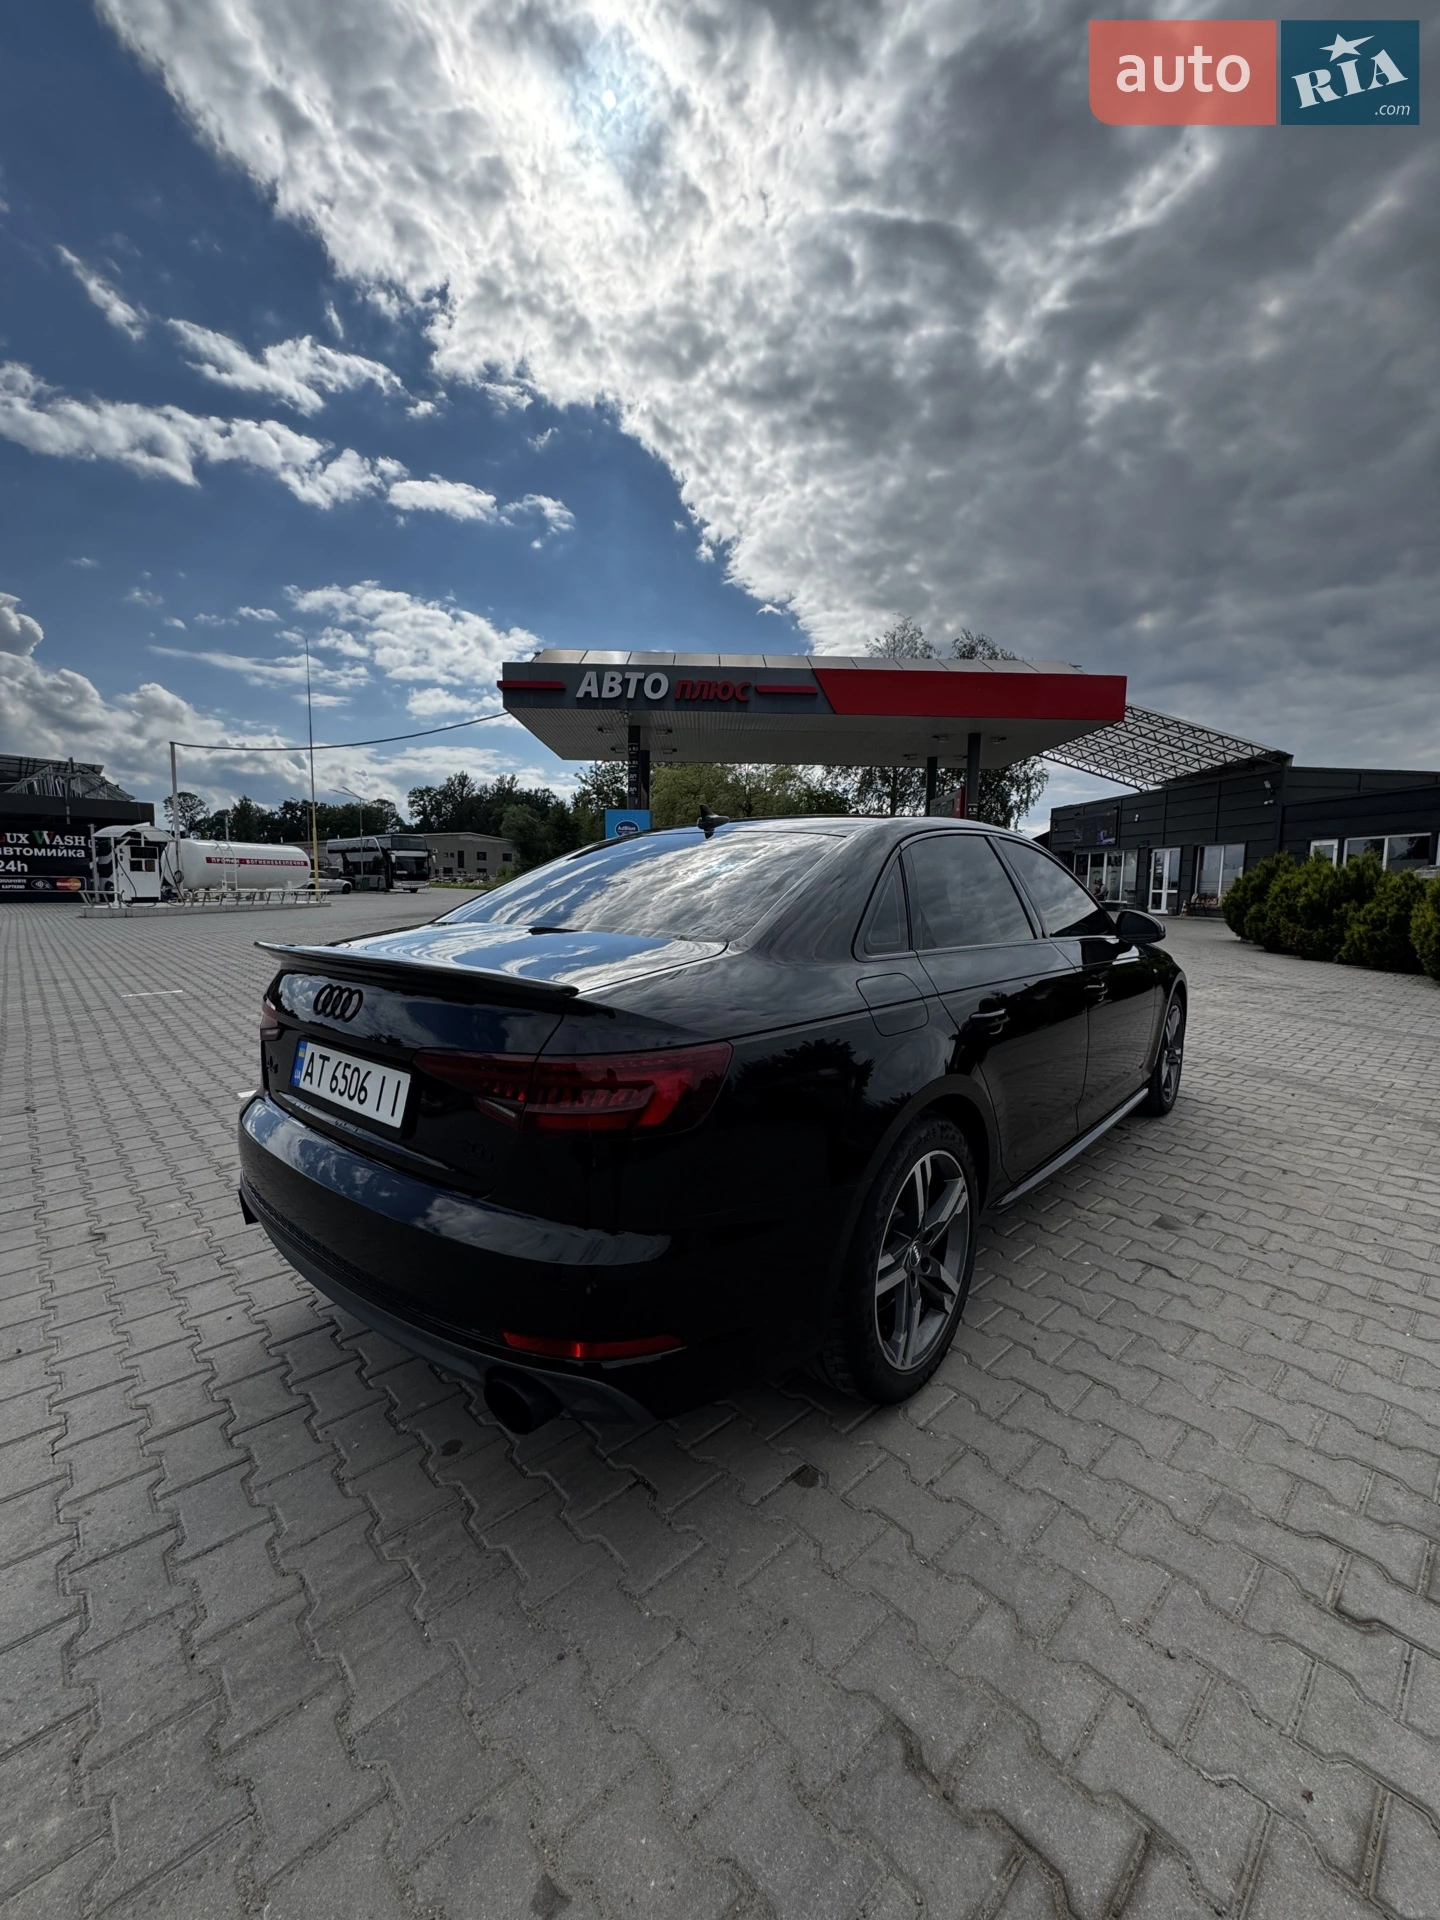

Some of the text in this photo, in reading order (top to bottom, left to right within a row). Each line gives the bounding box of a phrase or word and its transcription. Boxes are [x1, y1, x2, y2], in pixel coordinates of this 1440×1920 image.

[575, 671, 752, 701] АВТО ПЛЮС
[33, 830, 86, 846] WASH
[0, 846, 85, 858] втомийка
[303, 1051, 331, 1088] AT
[329, 1060, 372, 1105] 6506
